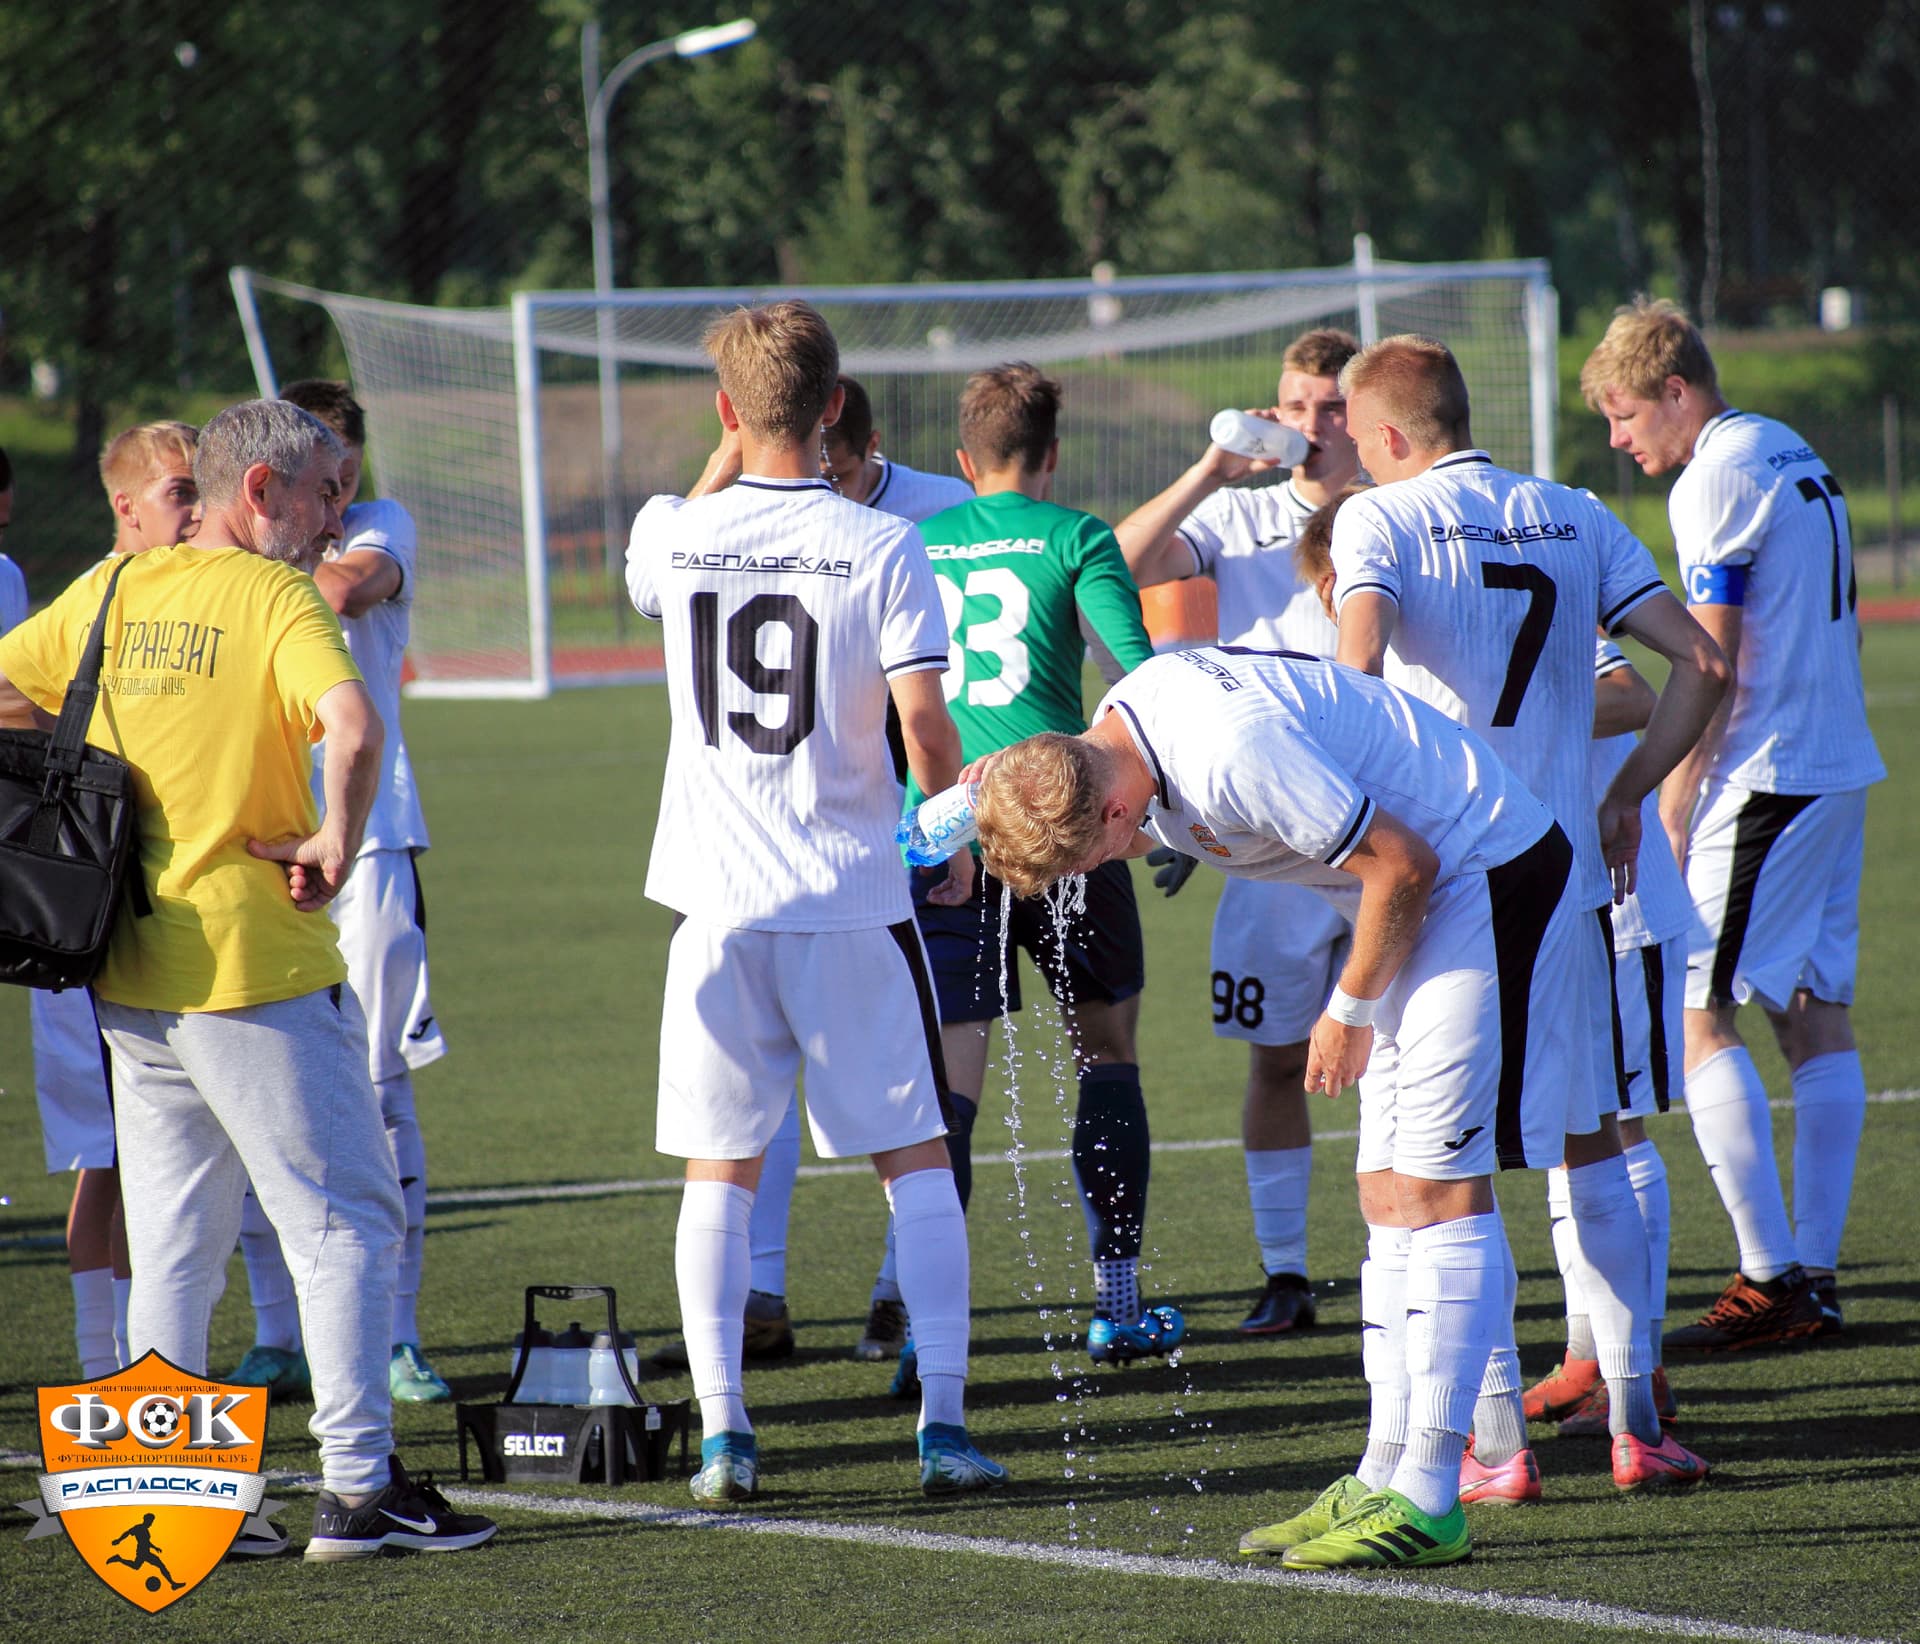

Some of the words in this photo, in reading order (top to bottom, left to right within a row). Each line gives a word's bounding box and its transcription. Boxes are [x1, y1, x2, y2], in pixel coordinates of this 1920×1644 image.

[925, 537, 1046, 560] СПАДСКАЯ
[1430, 523, 1578, 545] РАСПАДСКАЯ
[672, 552, 852, 578] РАСПАДСКАЯ
[1690, 566, 1713, 603] C
[1481, 561, 1557, 727] 7
[160, 676, 186, 696] КЛУБ
[690, 591, 819, 755] 19
[1175, 649, 1244, 692] РАСПАДС
[1212, 970, 1265, 1031] 98
[503, 1434, 566, 1457] SELECT
